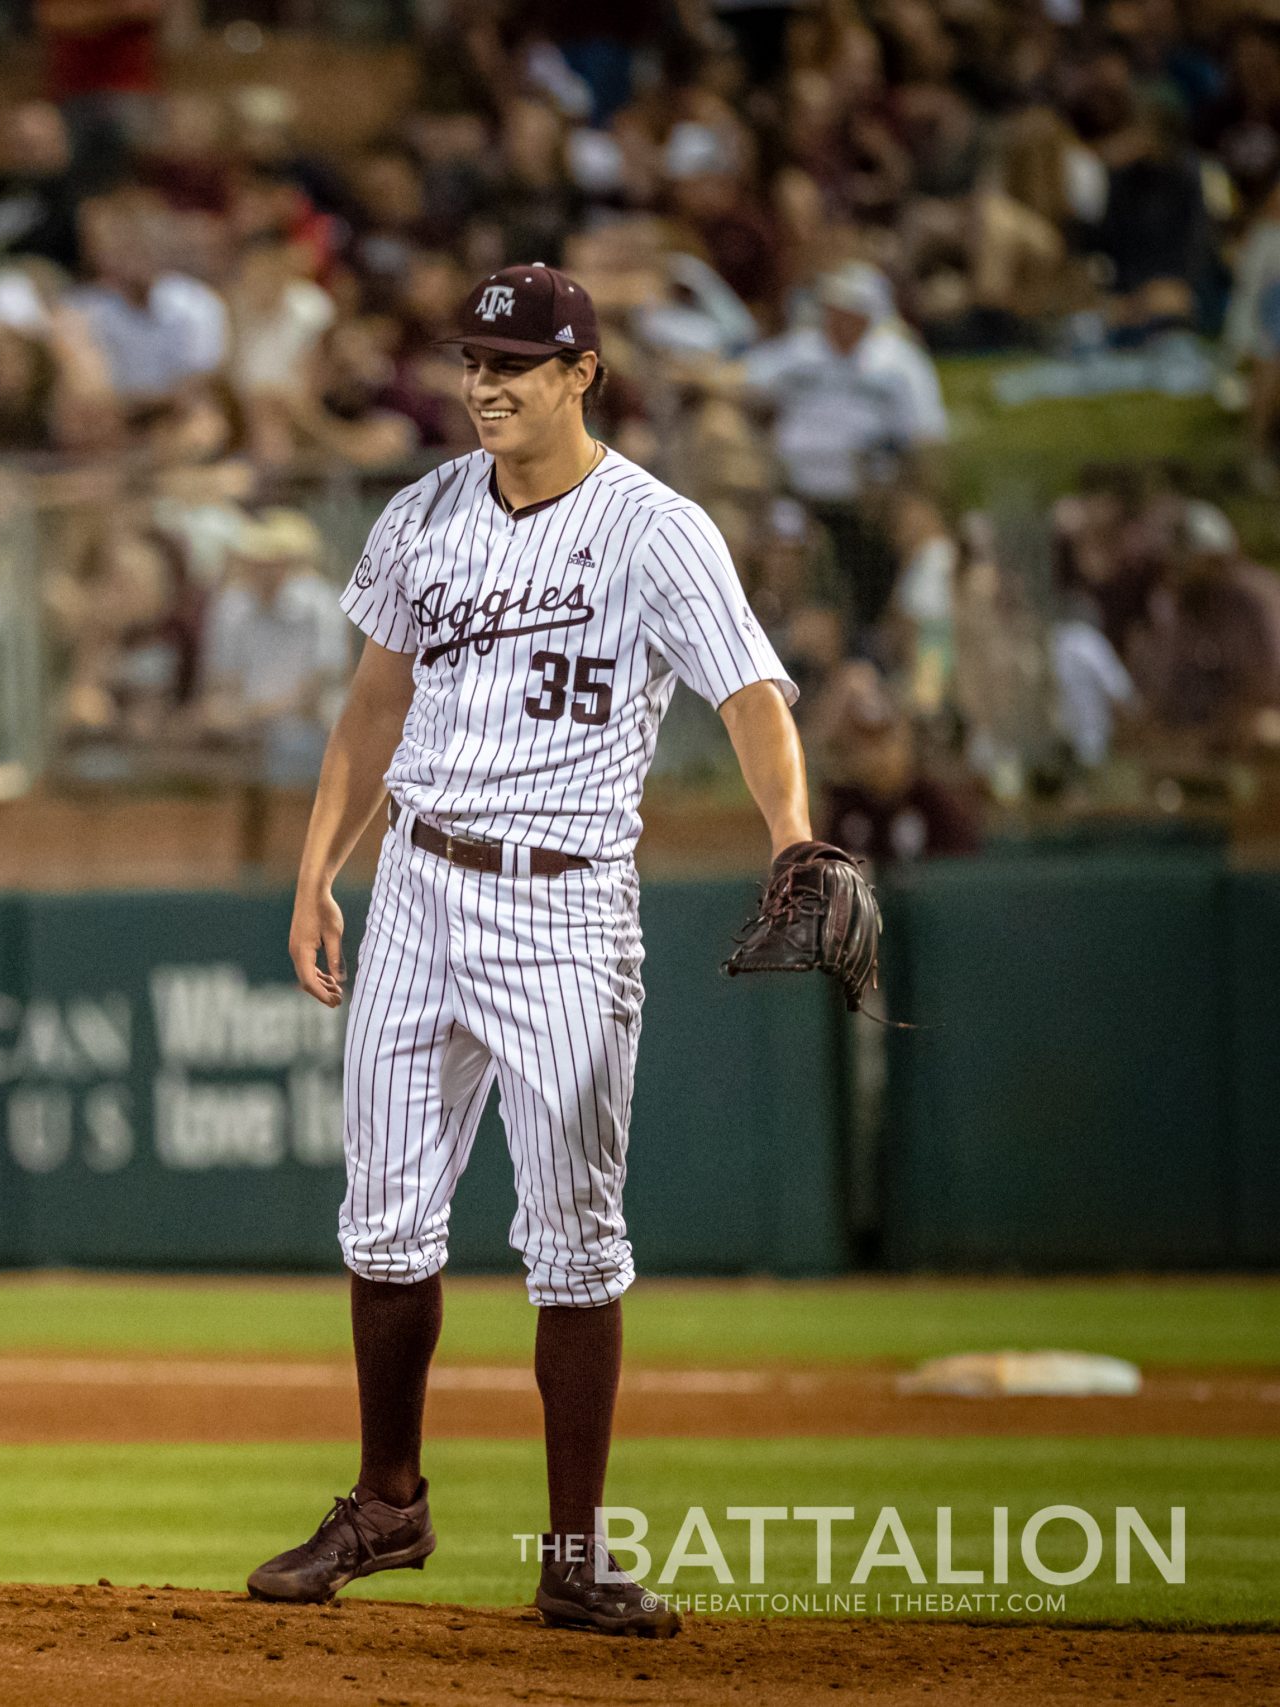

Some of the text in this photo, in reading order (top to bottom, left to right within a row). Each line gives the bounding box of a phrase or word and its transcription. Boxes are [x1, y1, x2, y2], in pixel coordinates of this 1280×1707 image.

[569, 557, 596, 569] adidas
[411, 577, 595, 669] Aggies
[525, 650, 617, 726] 35
